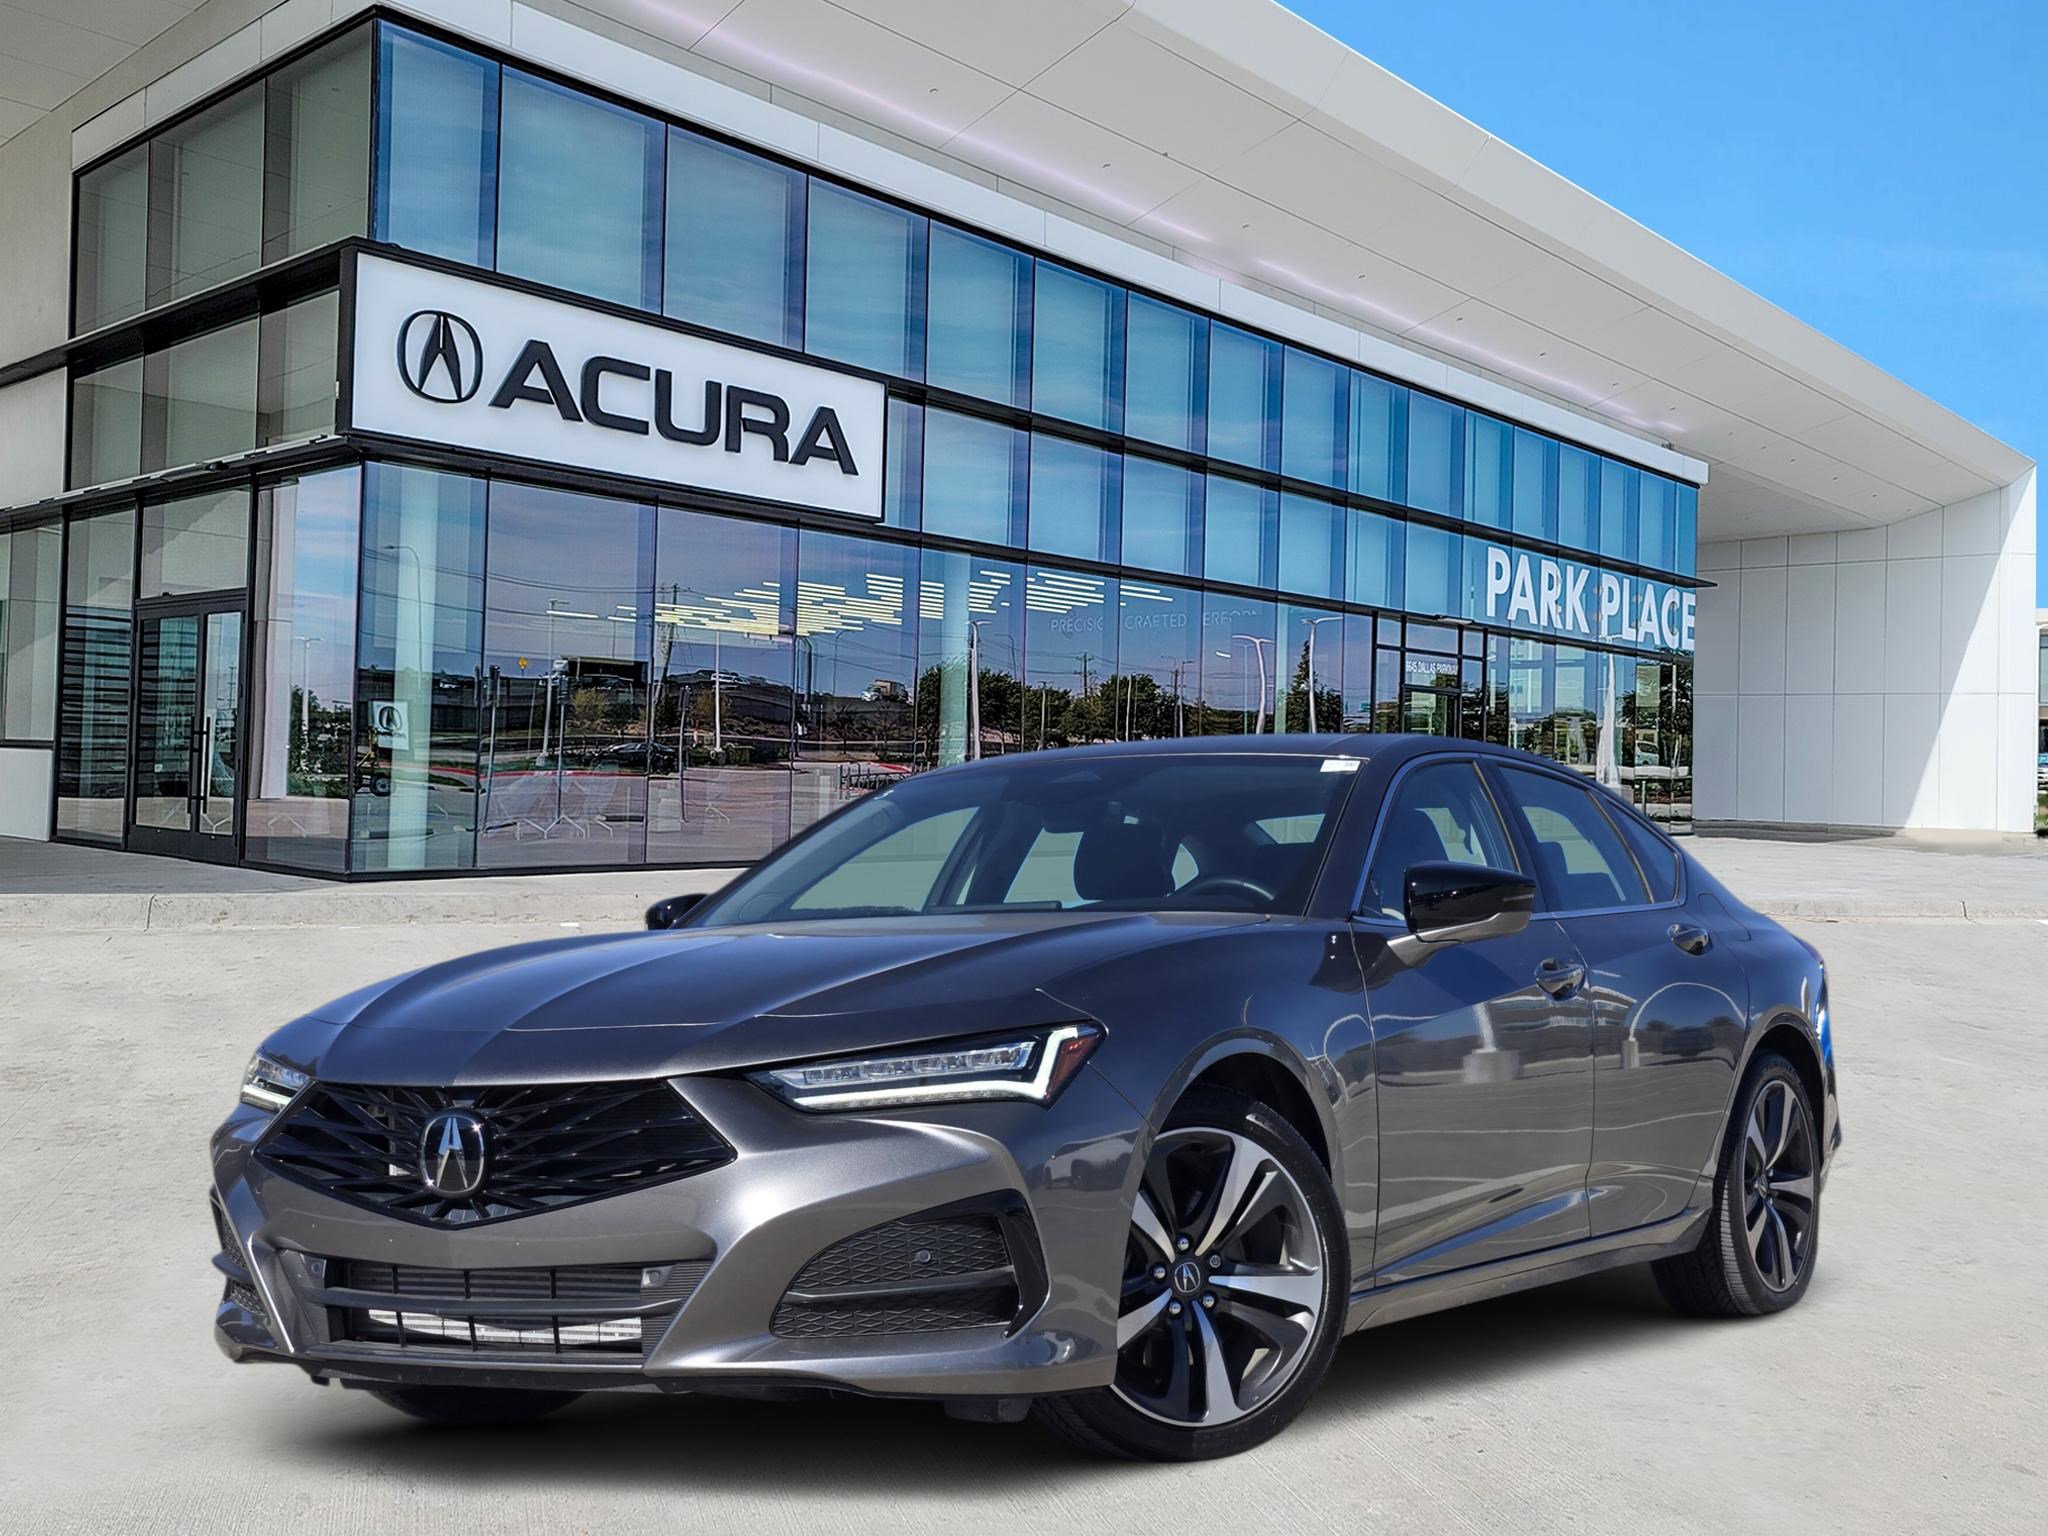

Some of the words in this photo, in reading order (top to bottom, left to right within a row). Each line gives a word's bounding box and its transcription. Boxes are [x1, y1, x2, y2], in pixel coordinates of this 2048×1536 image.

[488, 339, 858, 476] ACURA
[1124, 612, 1187, 630] CRAFTED
[1486, 546, 1591, 634] PARK
[1599, 572, 1696, 651] PLACE
